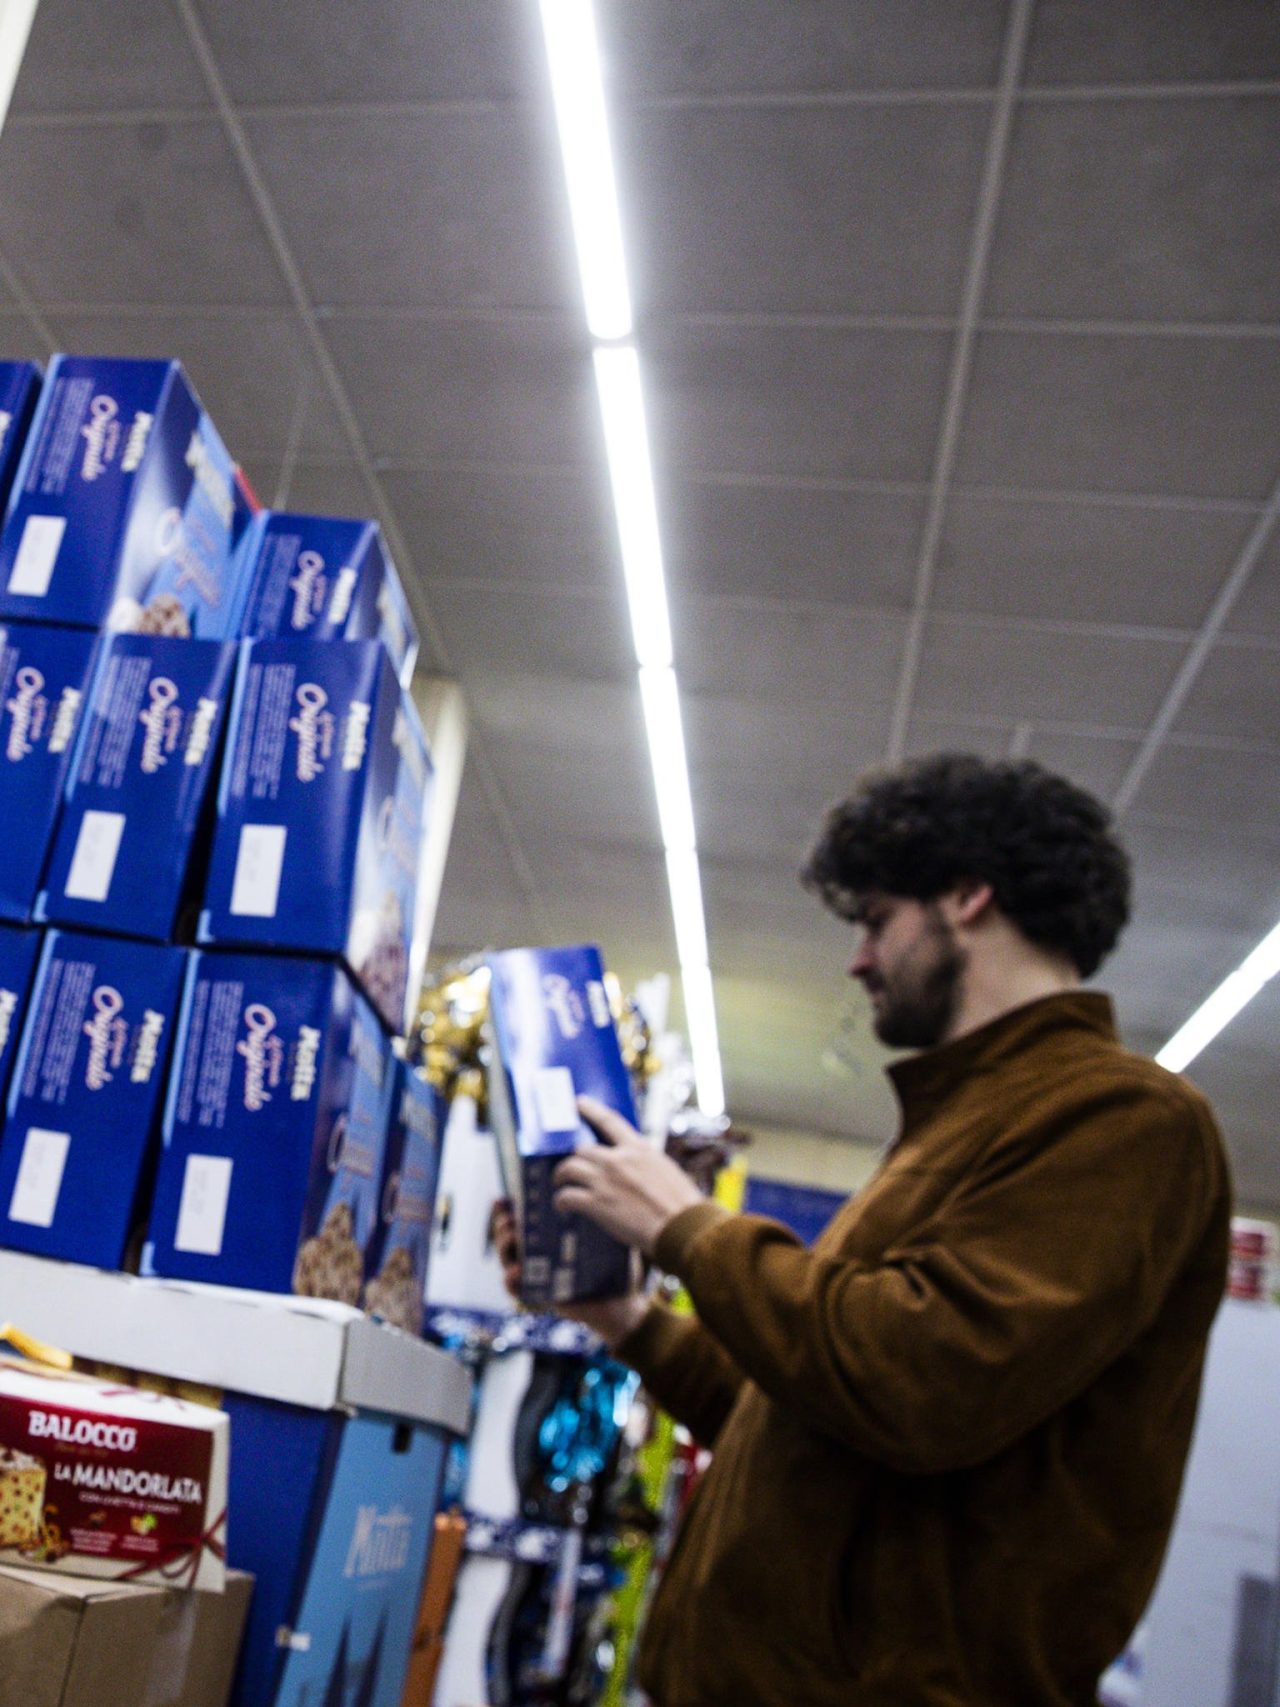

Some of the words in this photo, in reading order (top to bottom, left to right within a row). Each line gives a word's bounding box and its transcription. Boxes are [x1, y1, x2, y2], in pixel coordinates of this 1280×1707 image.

[290, 1024, 321, 1101] Motta
[28, 1410, 138, 1452] BALOCCO
[54, 1462, 71, 1481] LA
[72, 1463, 202, 1505] MANDORLATA
